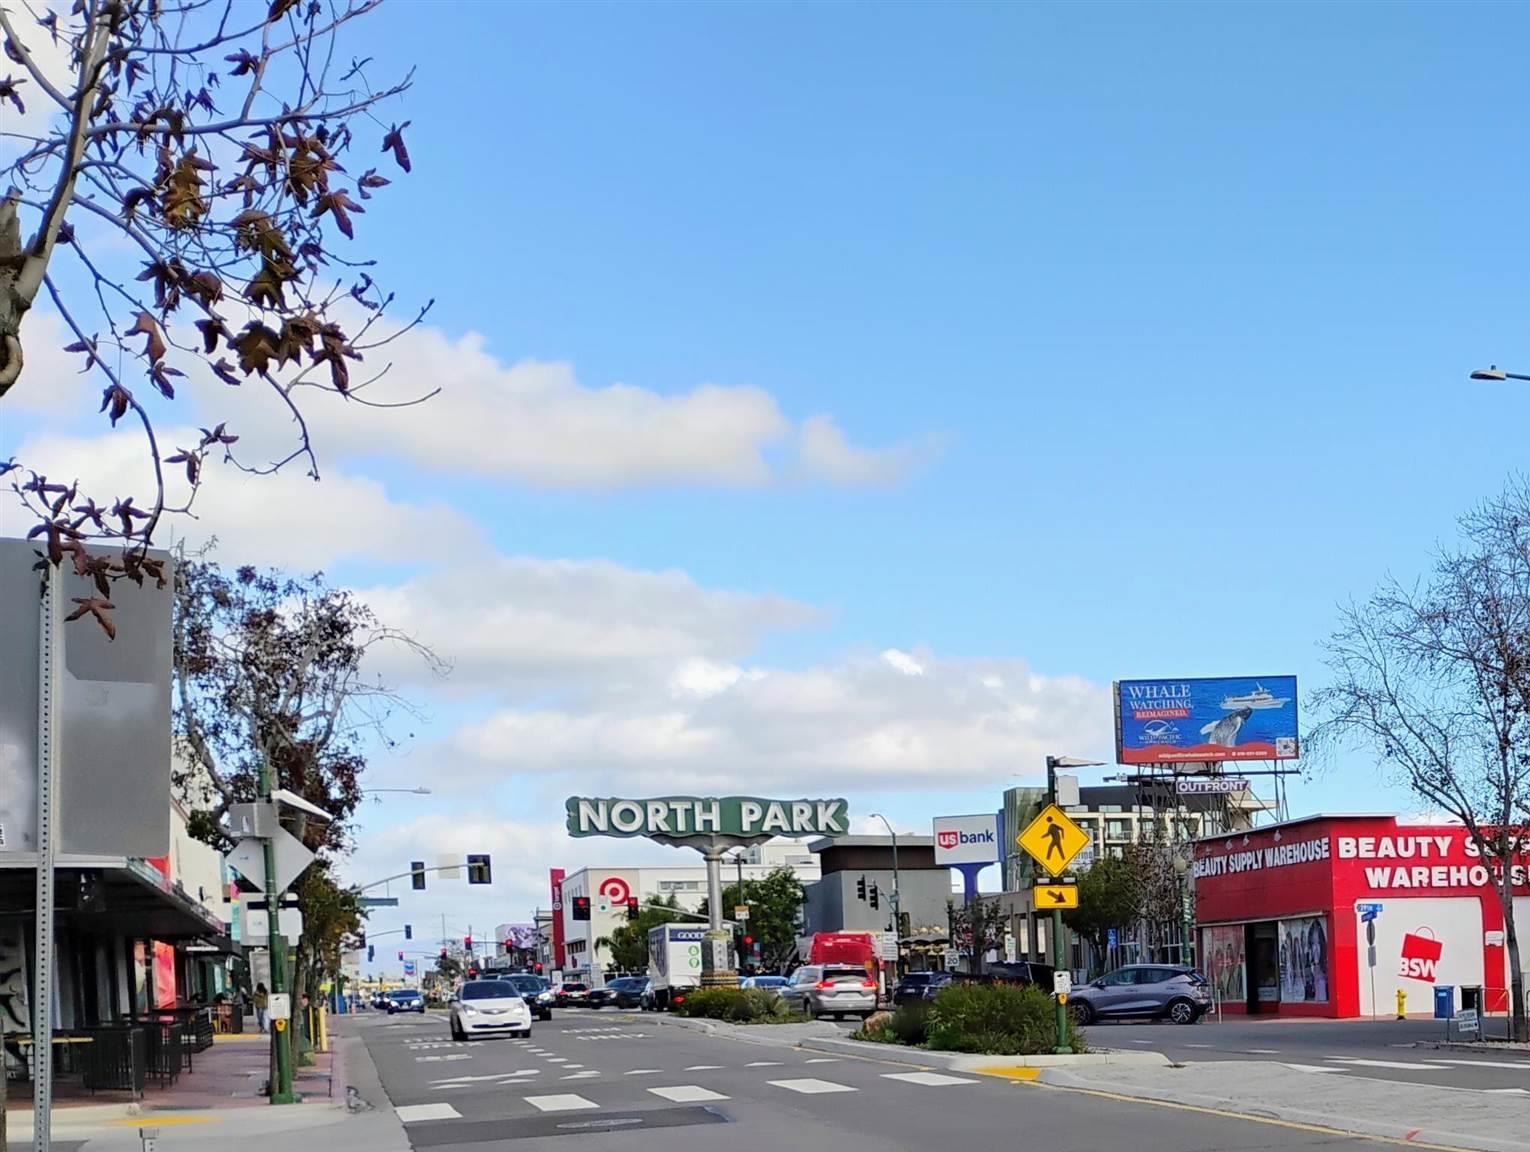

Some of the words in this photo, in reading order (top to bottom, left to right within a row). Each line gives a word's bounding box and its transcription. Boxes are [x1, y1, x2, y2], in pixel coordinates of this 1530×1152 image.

[1128, 684, 1191, 699] WHALE
[1178, 781, 1247, 792] OUTFRONT
[578, 800, 720, 833] NORTH
[741, 801, 845, 833] PARK
[939, 834, 958, 846] us
[960, 829, 994, 844] bank
[1193, 855, 1228, 878] BEAUTY
[1228, 849, 1263, 873] SUPPLY
[1264, 837, 1330, 868] WAREHOUSE
[1338, 837, 1453, 859] BEAUTY
[946, 957, 959, 965] 20
[1399, 957, 1440, 978] BSW
